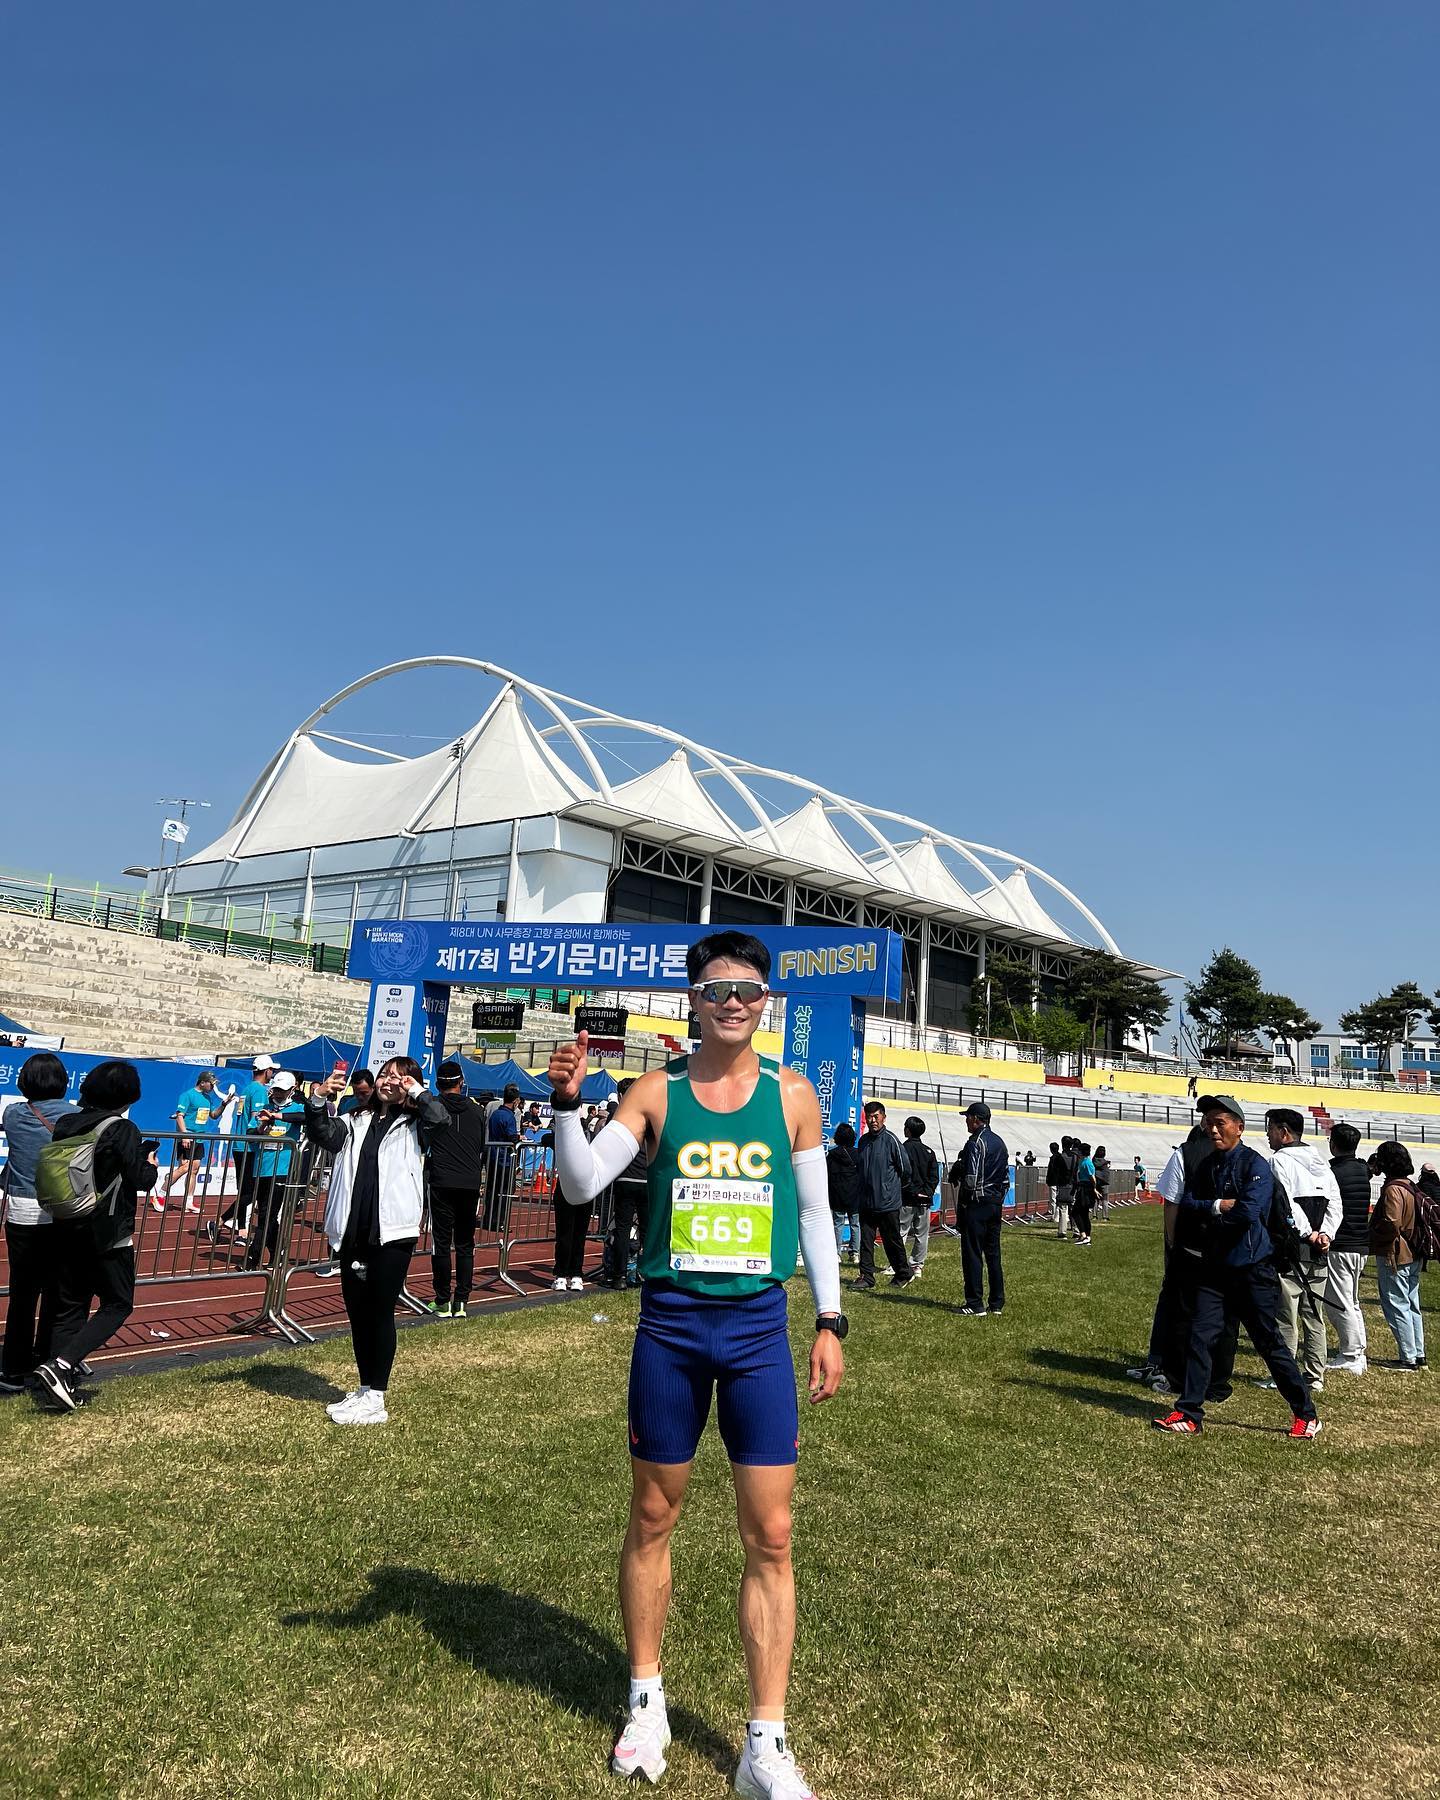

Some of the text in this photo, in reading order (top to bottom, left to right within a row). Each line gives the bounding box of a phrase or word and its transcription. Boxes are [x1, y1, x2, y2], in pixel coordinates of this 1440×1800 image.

[450, 927, 632, 941] 제8대 UN 사무총장 고향 음성에서 함께하는
[436, 942, 689, 978] 제17회 반기문마라톤
[778, 942, 877, 979] FINISH
[422, 996, 448, 1015] 제17회
[587, 1010, 618, 1018] SAMIK
[792, 1005, 813, 1059] 상상이
[677, 1141, 773, 1179] CRC
[692, 1190, 770, 1203] 반기문마라톤대회
[691, 1215, 753, 1243] 669
